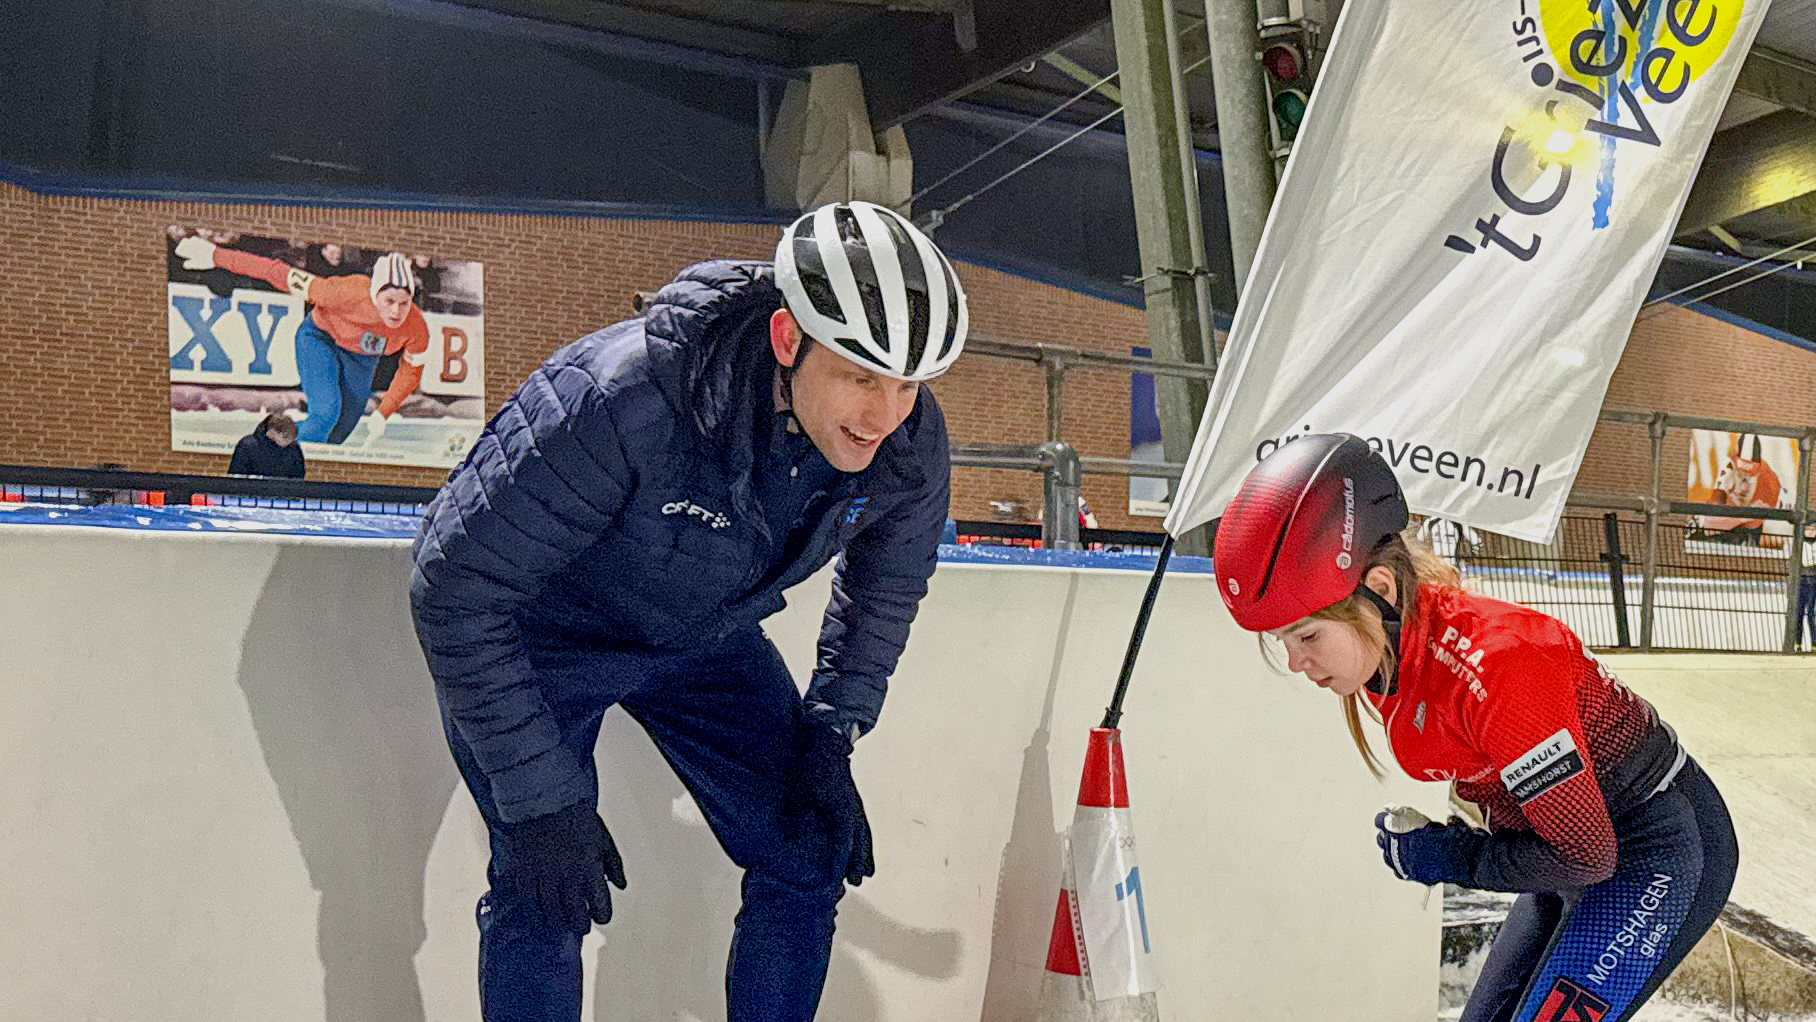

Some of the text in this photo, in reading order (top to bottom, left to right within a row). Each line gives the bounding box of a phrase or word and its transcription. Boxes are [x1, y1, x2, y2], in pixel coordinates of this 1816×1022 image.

[170, 294, 289, 376] XY
[440, 326, 469, 383] B
[1505, 740, 1563, 785] RENAULT
[1516, 758, 1574, 799] AMSHORST
[1115, 866, 1151, 954] 1
[1586, 872, 1673, 987] MOTSHAGEN
[1639, 922, 1668, 959] glas
